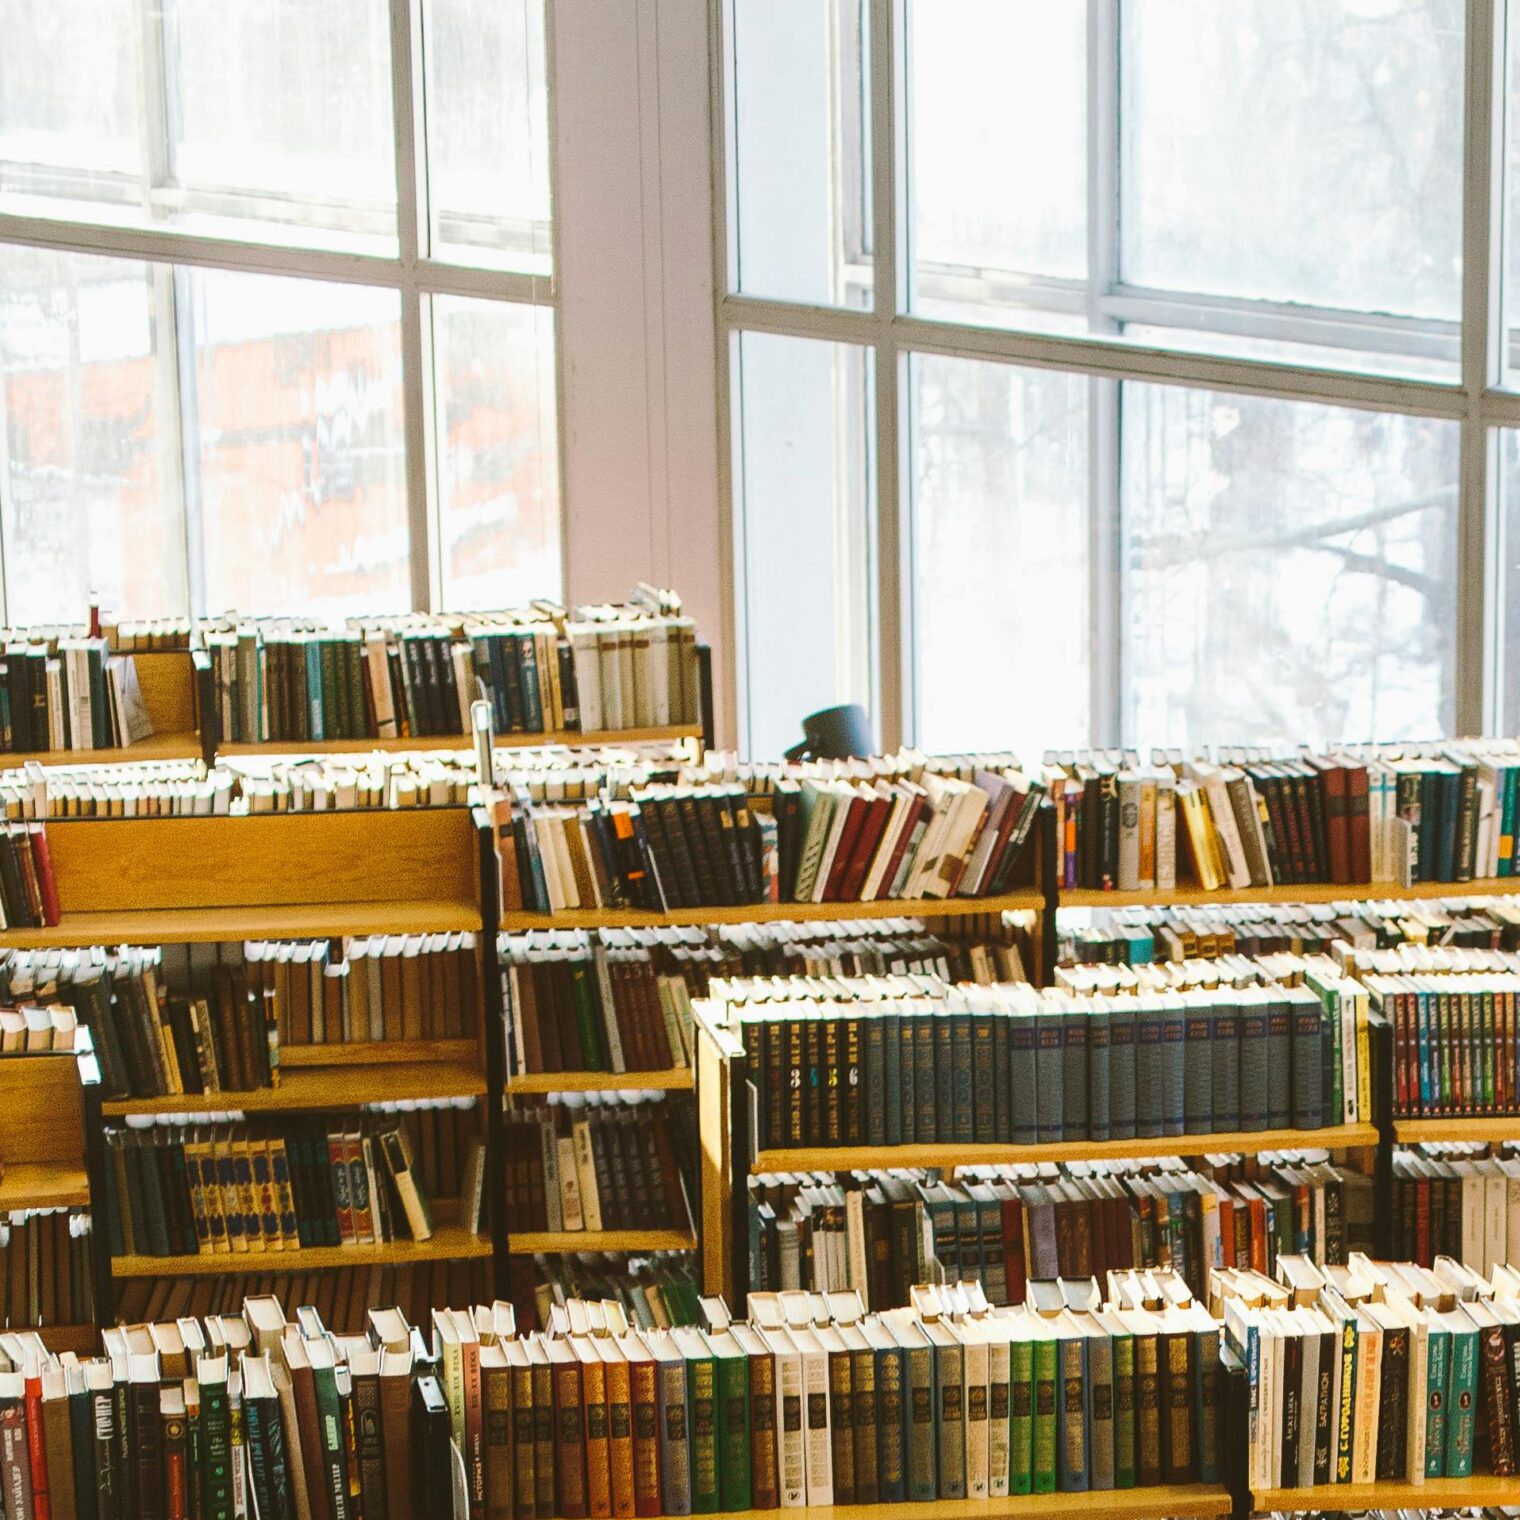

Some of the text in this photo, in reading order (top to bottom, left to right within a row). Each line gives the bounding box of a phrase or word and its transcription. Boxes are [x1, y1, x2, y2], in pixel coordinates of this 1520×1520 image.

[791, 1068, 800, 1086] 3
[828, 1068, 837, 1086] 5
[848, 1068, 858, 1086] 6
[1319, 1372, 1329, 1427] БАГРАТИОН
[325, 1415, 338, 1451] БАНКИР
[13, 1466, 24, 1505] УАЙЛДЕР
